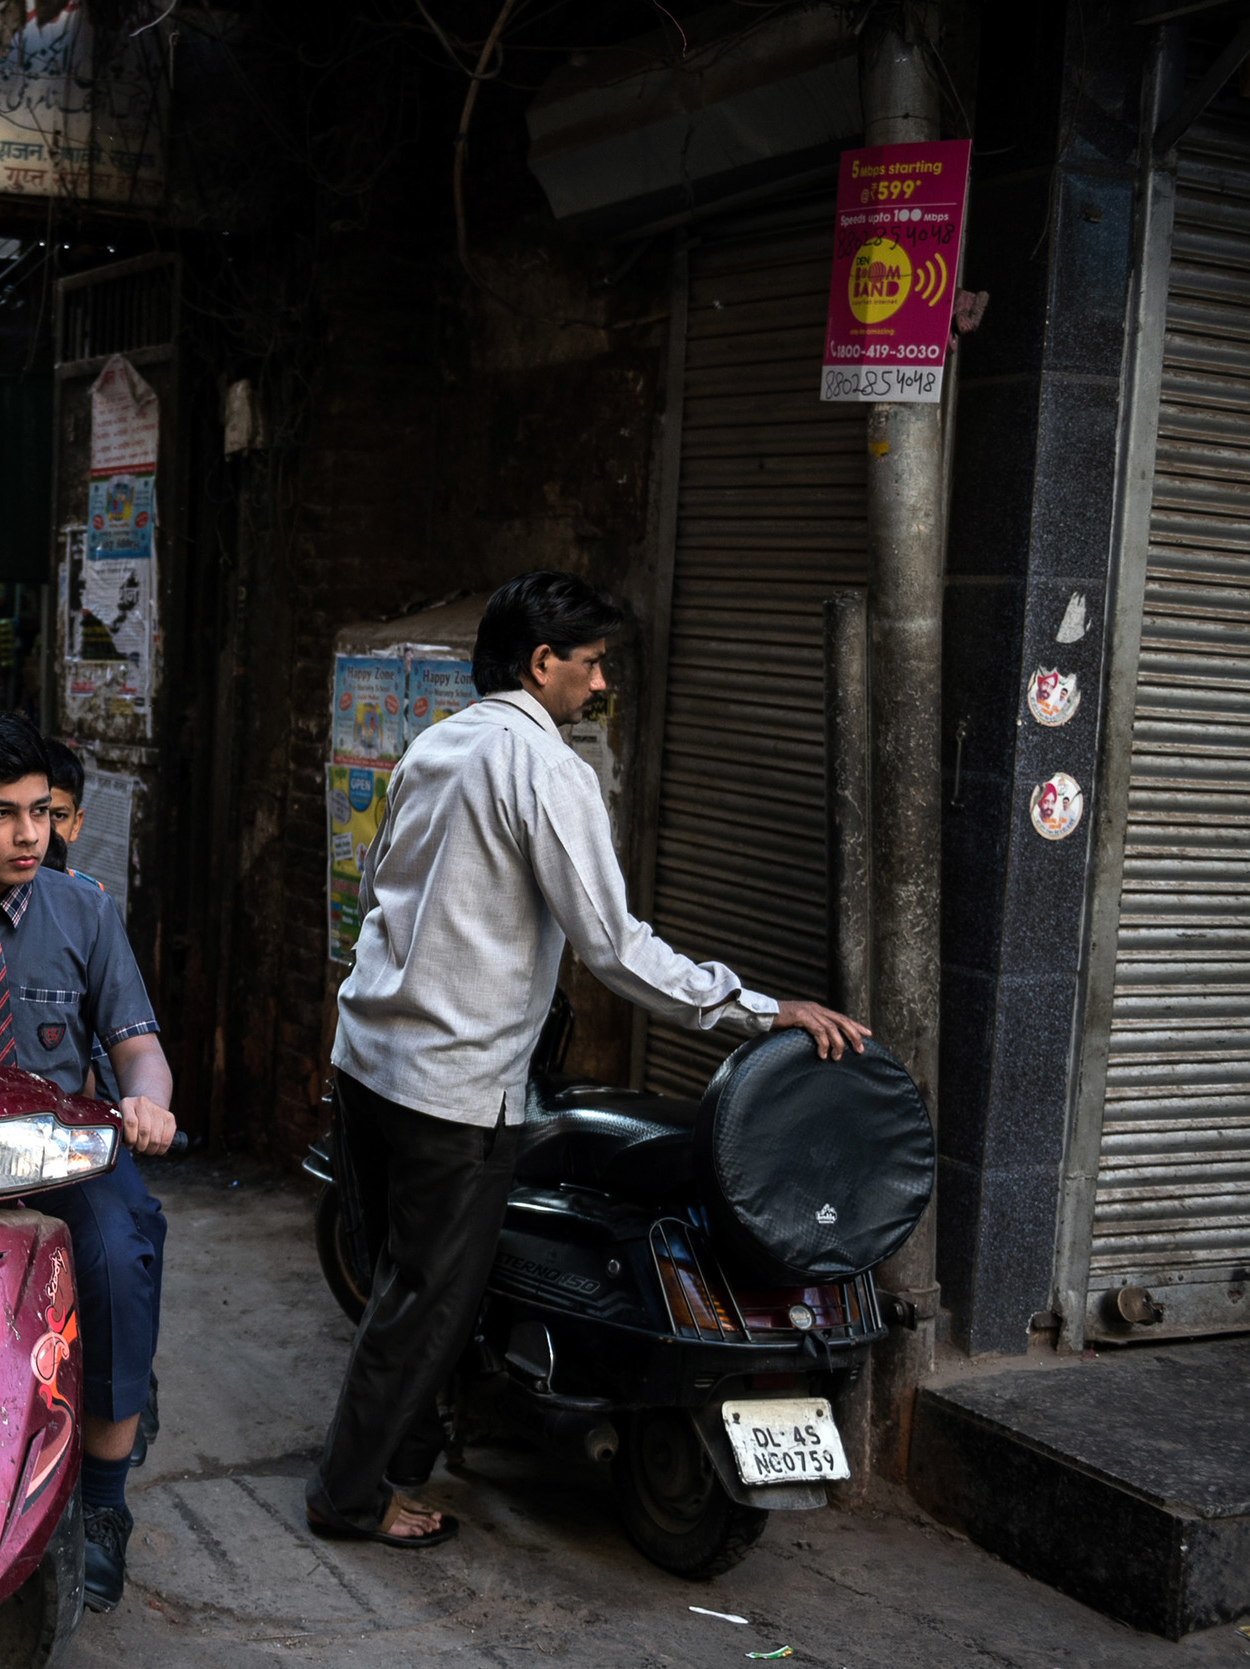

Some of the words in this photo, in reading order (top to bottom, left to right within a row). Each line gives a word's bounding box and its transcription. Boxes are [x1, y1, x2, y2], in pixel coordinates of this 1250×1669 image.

[888, 160, 942, 176] starting
[840, 212, 866, 227] Speeds
[868, 211, 891, 225] upto
[893, 208, 922, 222] 100
[924, 213, 949, 223] Mbps
[853, 281, 901, 298] BAND
[837, 344, 940, 359] 1800-419-3030
[347, 666, 372, 682] Happy
[375, 666, 395, 681] Zone
[422, 669, 451, 687] Happy
[350, 778, 372, 791] OPEN
